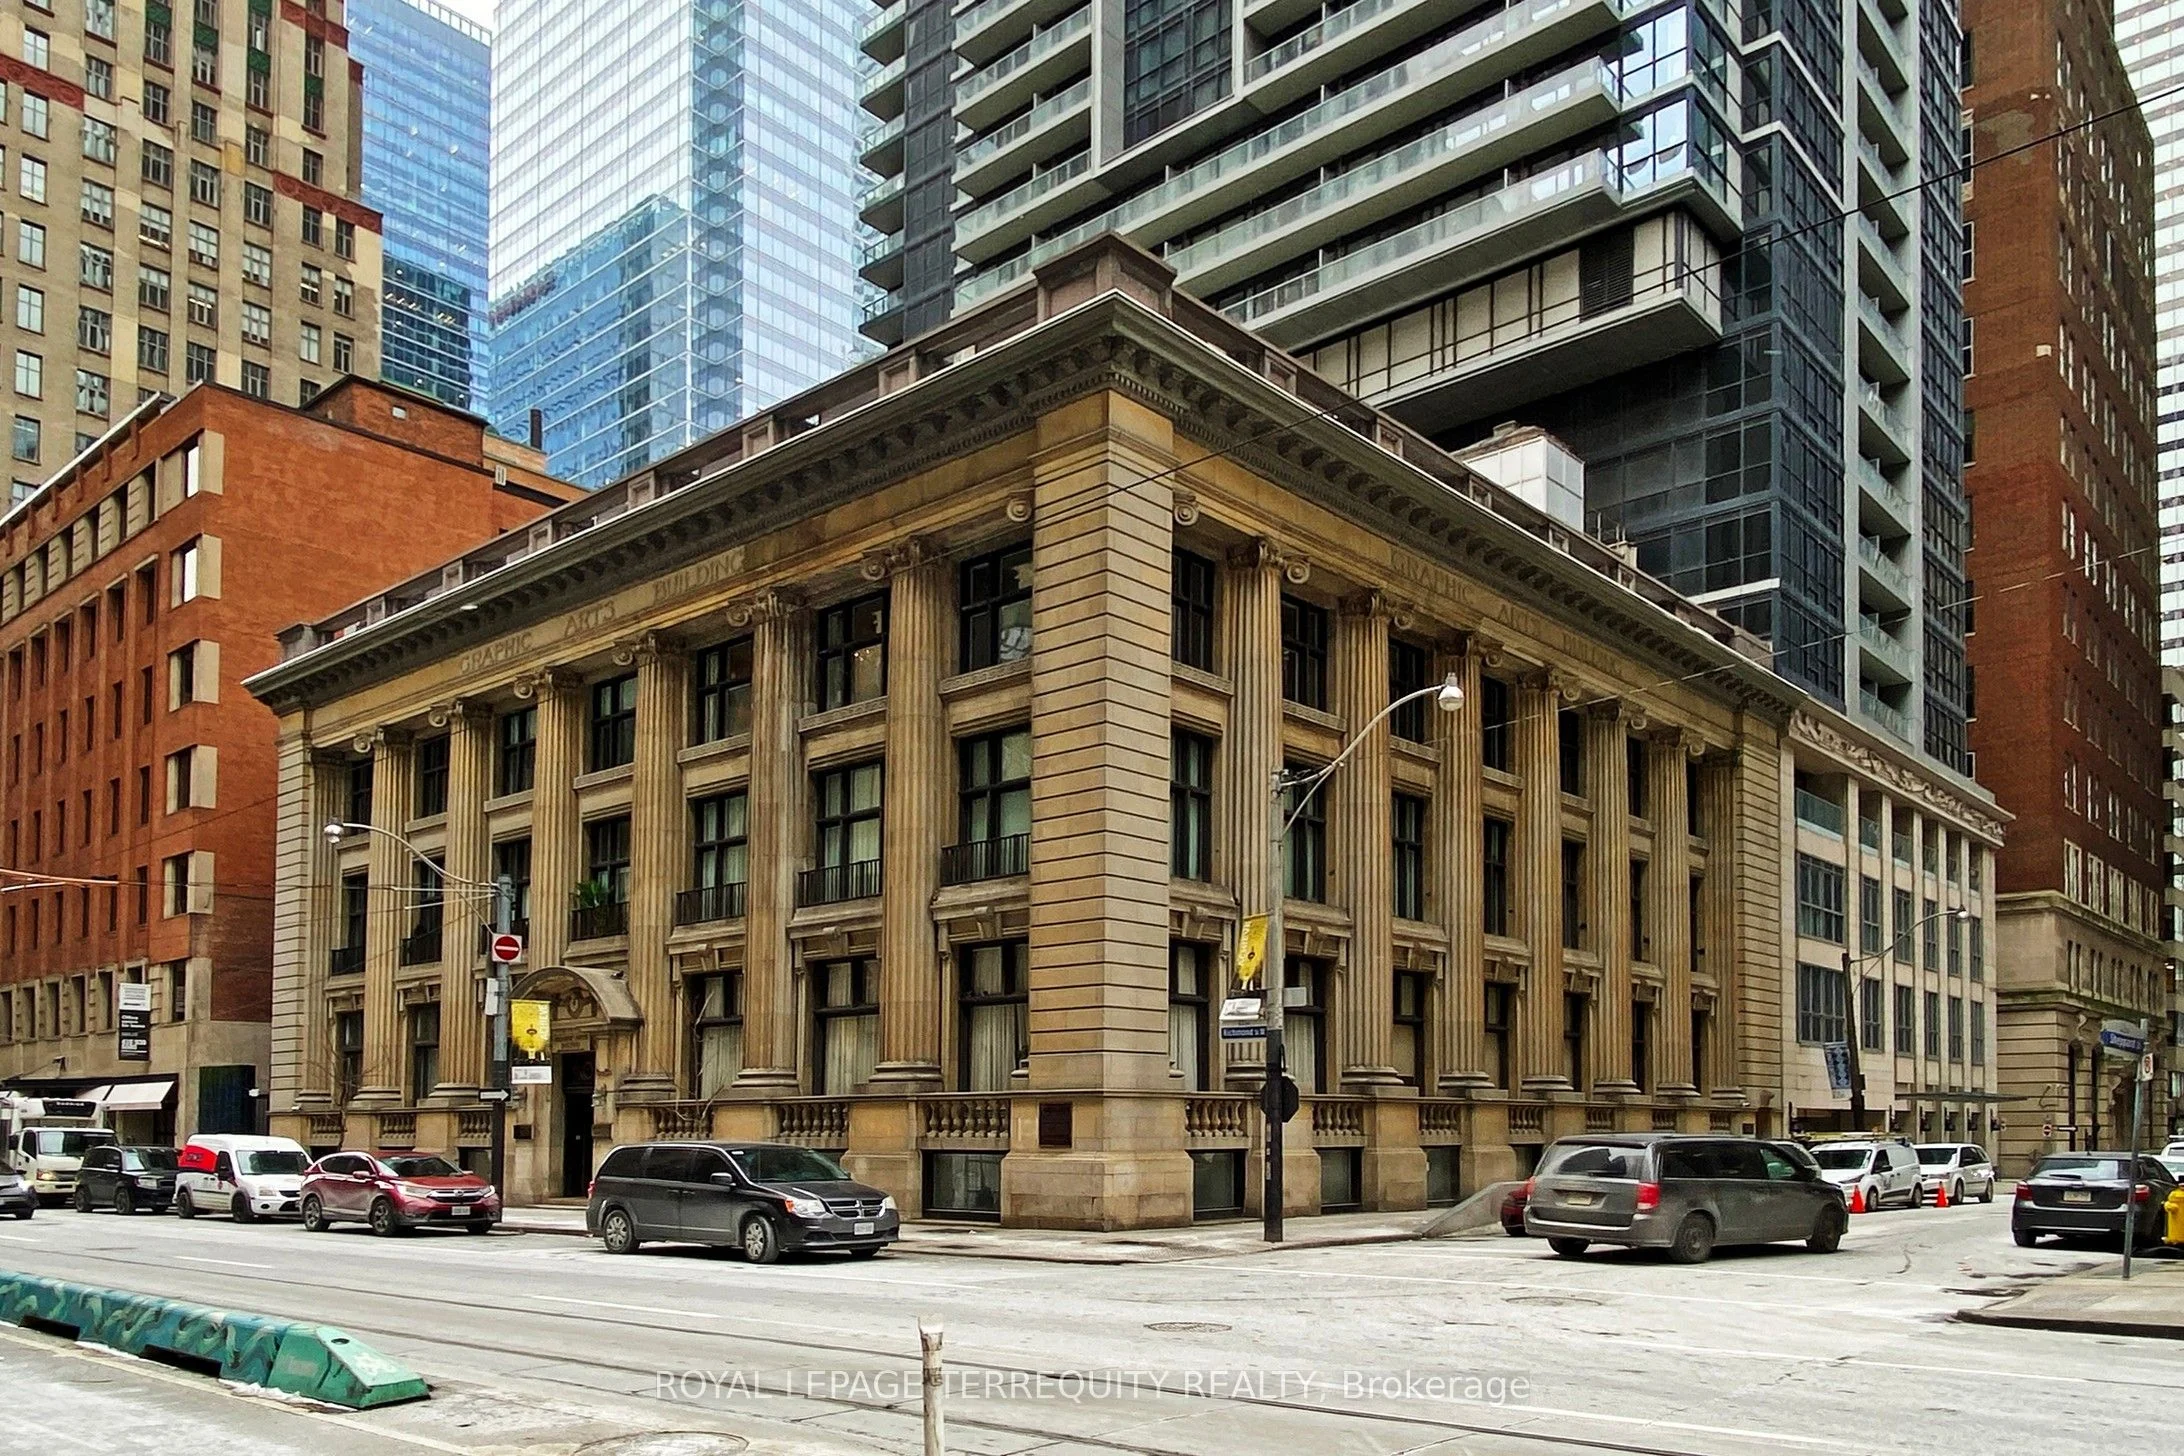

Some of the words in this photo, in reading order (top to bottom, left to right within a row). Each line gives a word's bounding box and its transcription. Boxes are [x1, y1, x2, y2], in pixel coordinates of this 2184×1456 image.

[459, 631, 533, 672] GRAPHIC
[564, 601, 617, 637] ARTS
[654, 551, 746, 600] BUILDING
